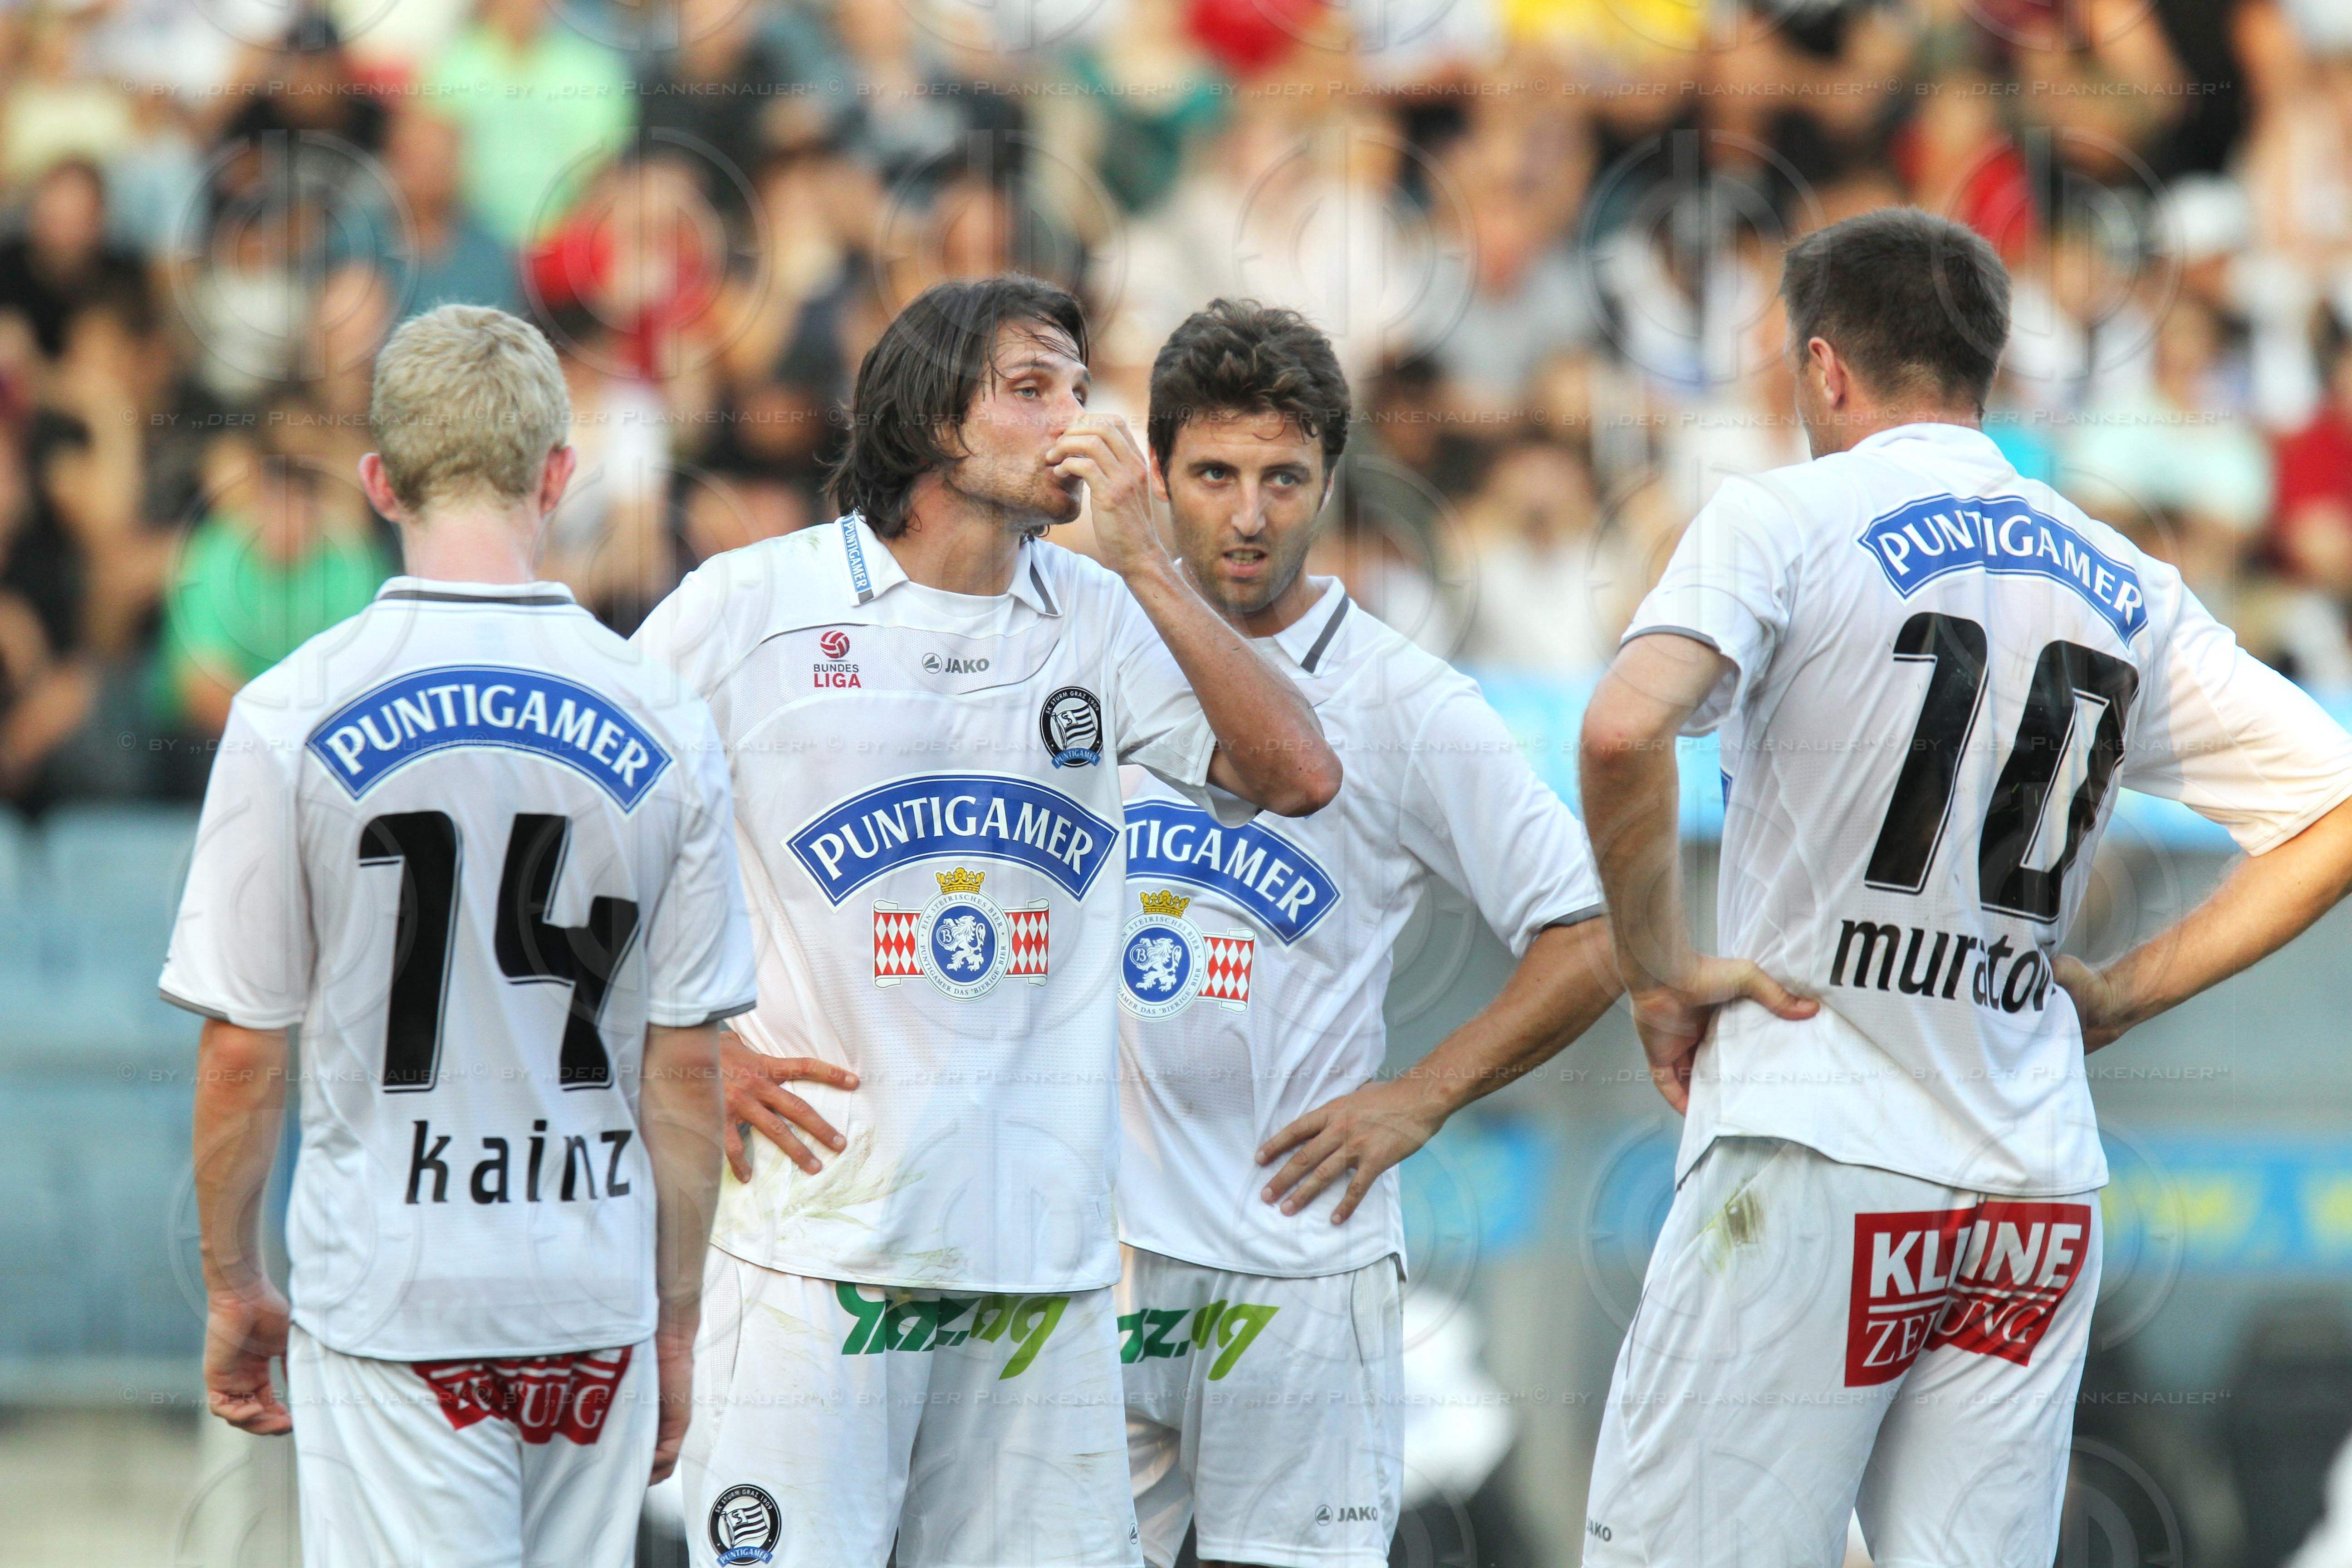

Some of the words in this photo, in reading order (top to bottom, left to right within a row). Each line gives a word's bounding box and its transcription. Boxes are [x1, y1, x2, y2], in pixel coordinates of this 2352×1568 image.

[843, 522, 867, 588] PUNTIGAMER
[813, 664, 859, 672] BUNDES
[813, 673, 861, 688] LIGA
[945, 658, 990, 673] JAKO
[1046, 705, 1052, 714] SK
[1050, 691, 1068, 706] STURM
[1070, 691, 1086, 699] GRAZ
[325, 684, 649, 788] PUNTIGAMER
[1055, 750, 1098, 764] PUNTIGAMER
[1865, 611, 2140, 925] 10
[809, 795, 1094, 881] PUNTIGAMER
[1126, 819, 1316, 924] TIGAMER
[921, 915, 932, 929] EIN
[932, 894, 987, 912] STEIRISCHES
[988, 907, 1003, 929] BIER
[359, 809, 641, 1093] 14
[1129, 916, 1187, 931] STEIRISCHES
[1187, 931, 1199, 951] BIER
[920, 945, 951, 992] PUNTIGAMER
[1118, 987, 1137, 1010] GAMER
[1192, 968, 1201, 987] BIER
[405, 1120, 632, 1205] kainz
[721, 1490, 740, 1504] STURM
[742, 1489, 758, 1497] GRAZ
[760, 1496, 772, 1509] 1909
[1338, 1506, 1378, 1522] JAKO
[1587, 1520, 1611, 1542] AKO
[720, 1549, 768, 1563] PUNTIGAMER
